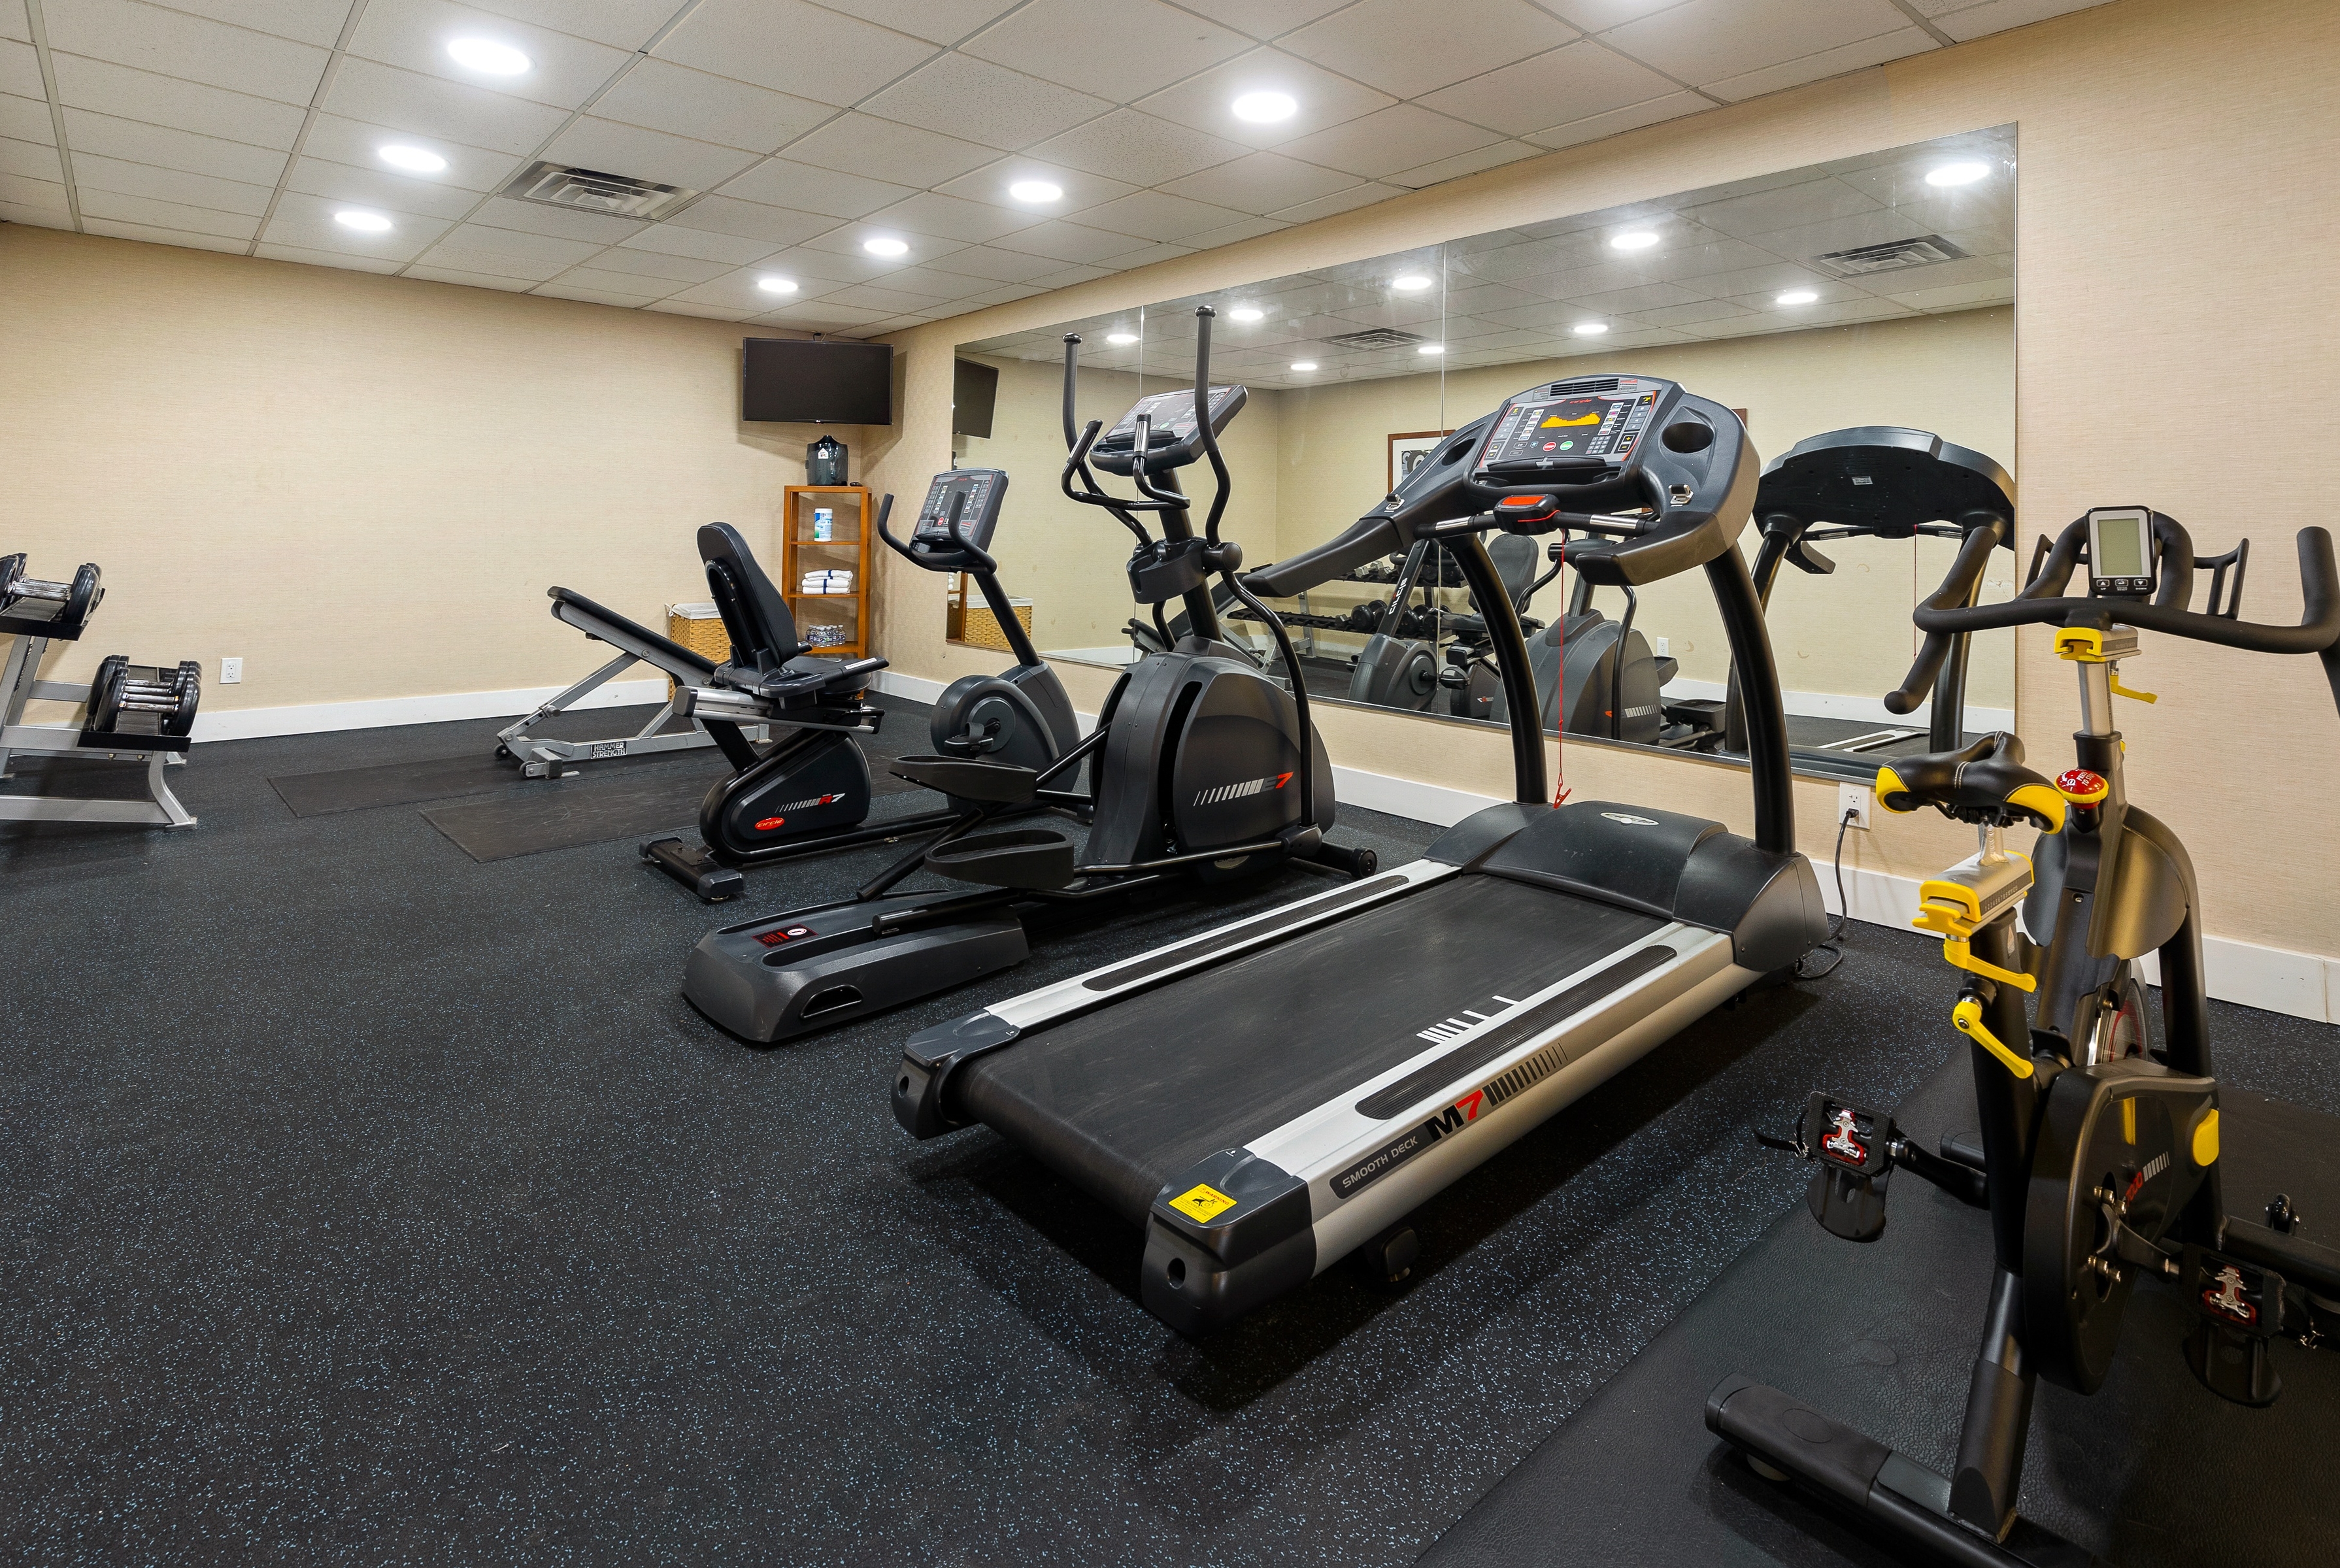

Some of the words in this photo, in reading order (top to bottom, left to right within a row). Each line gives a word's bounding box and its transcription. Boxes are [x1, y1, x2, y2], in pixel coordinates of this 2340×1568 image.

[592, 748, 626, 758] STRENGTH
[594, 742, 624, 751] HAMMER
[1261, 771, 1294, 792] E7
[818, 792, 846, 805] R7
[757, 819, 783, 827] circle
[1423, 1089, 1484, 1142] M7
[1342, 1154, 1389, 1189] SMOOTH
[1390, 1135, 1418, 1159] DECK
[1206, 1191, 1229, 1205] WARNING
